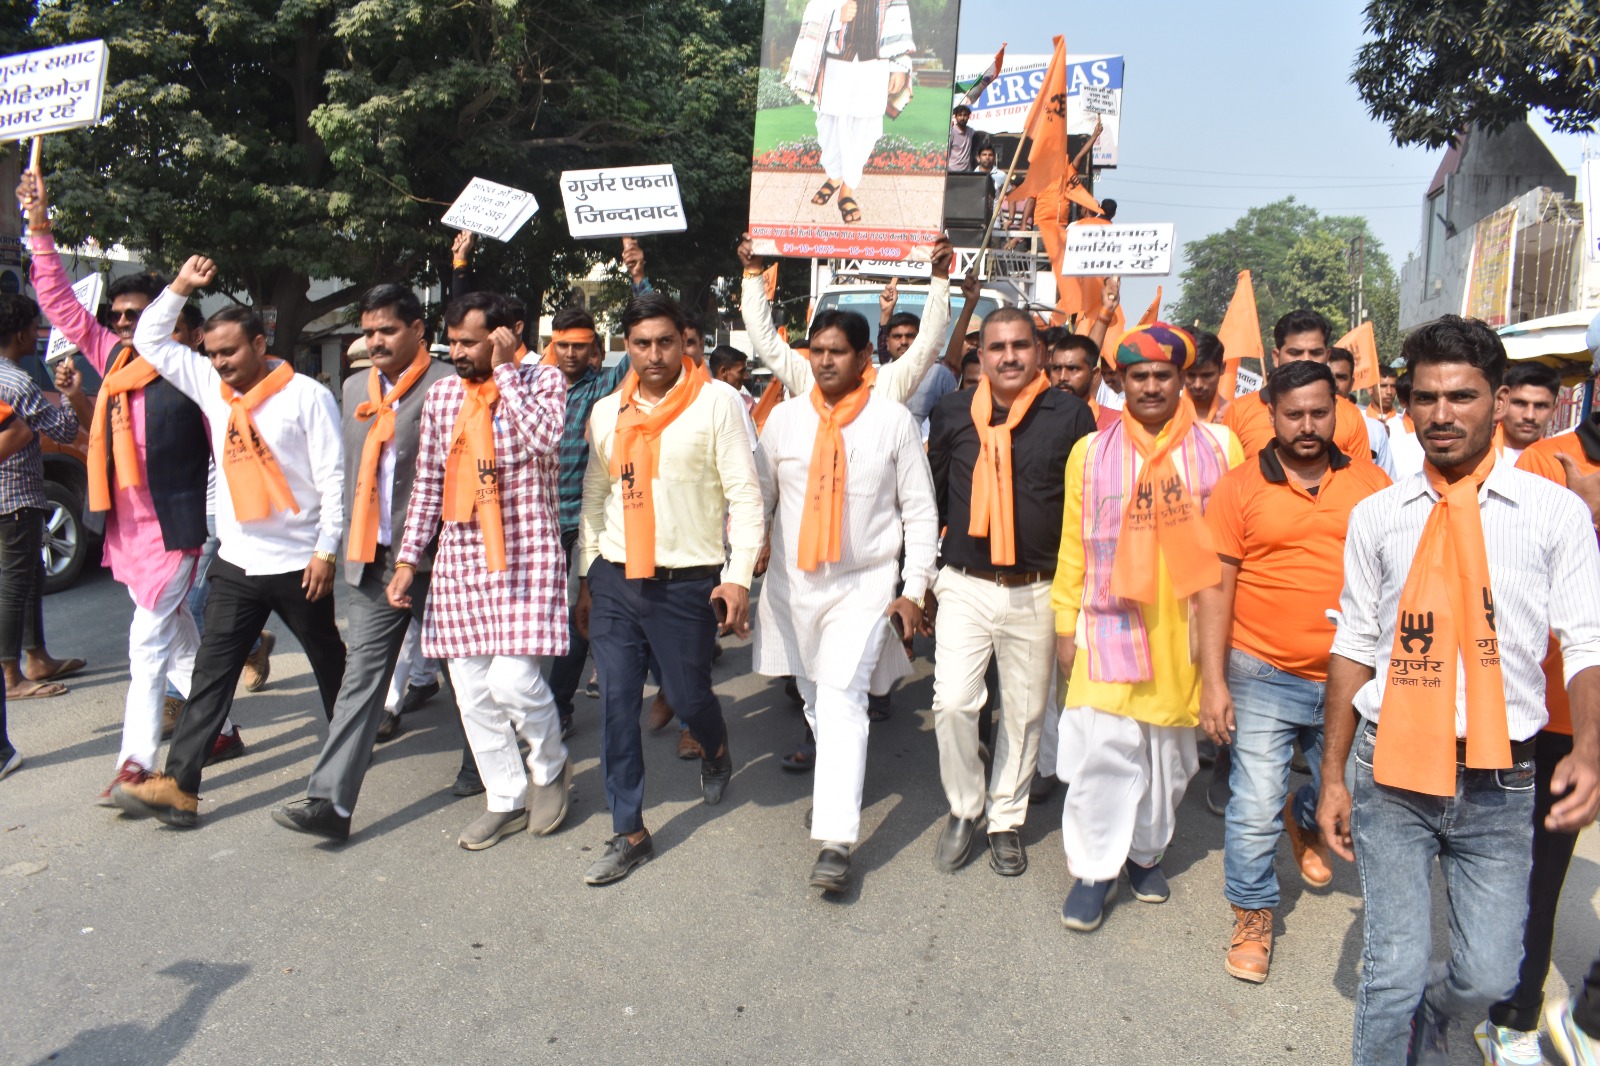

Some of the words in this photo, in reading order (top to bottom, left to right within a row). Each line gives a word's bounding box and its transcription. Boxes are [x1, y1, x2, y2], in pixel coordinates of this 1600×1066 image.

[566, 172, 617, 201] गुर्जर
[620, 174, 674, 191] एकता
[574, 204, 679, 225] जिन्दाबाद
[1391, 655, 1444, 676] गुर्जर
[1392, 677, 1418, 687] एकता
[1420, 676, 1441, 688] रैली
